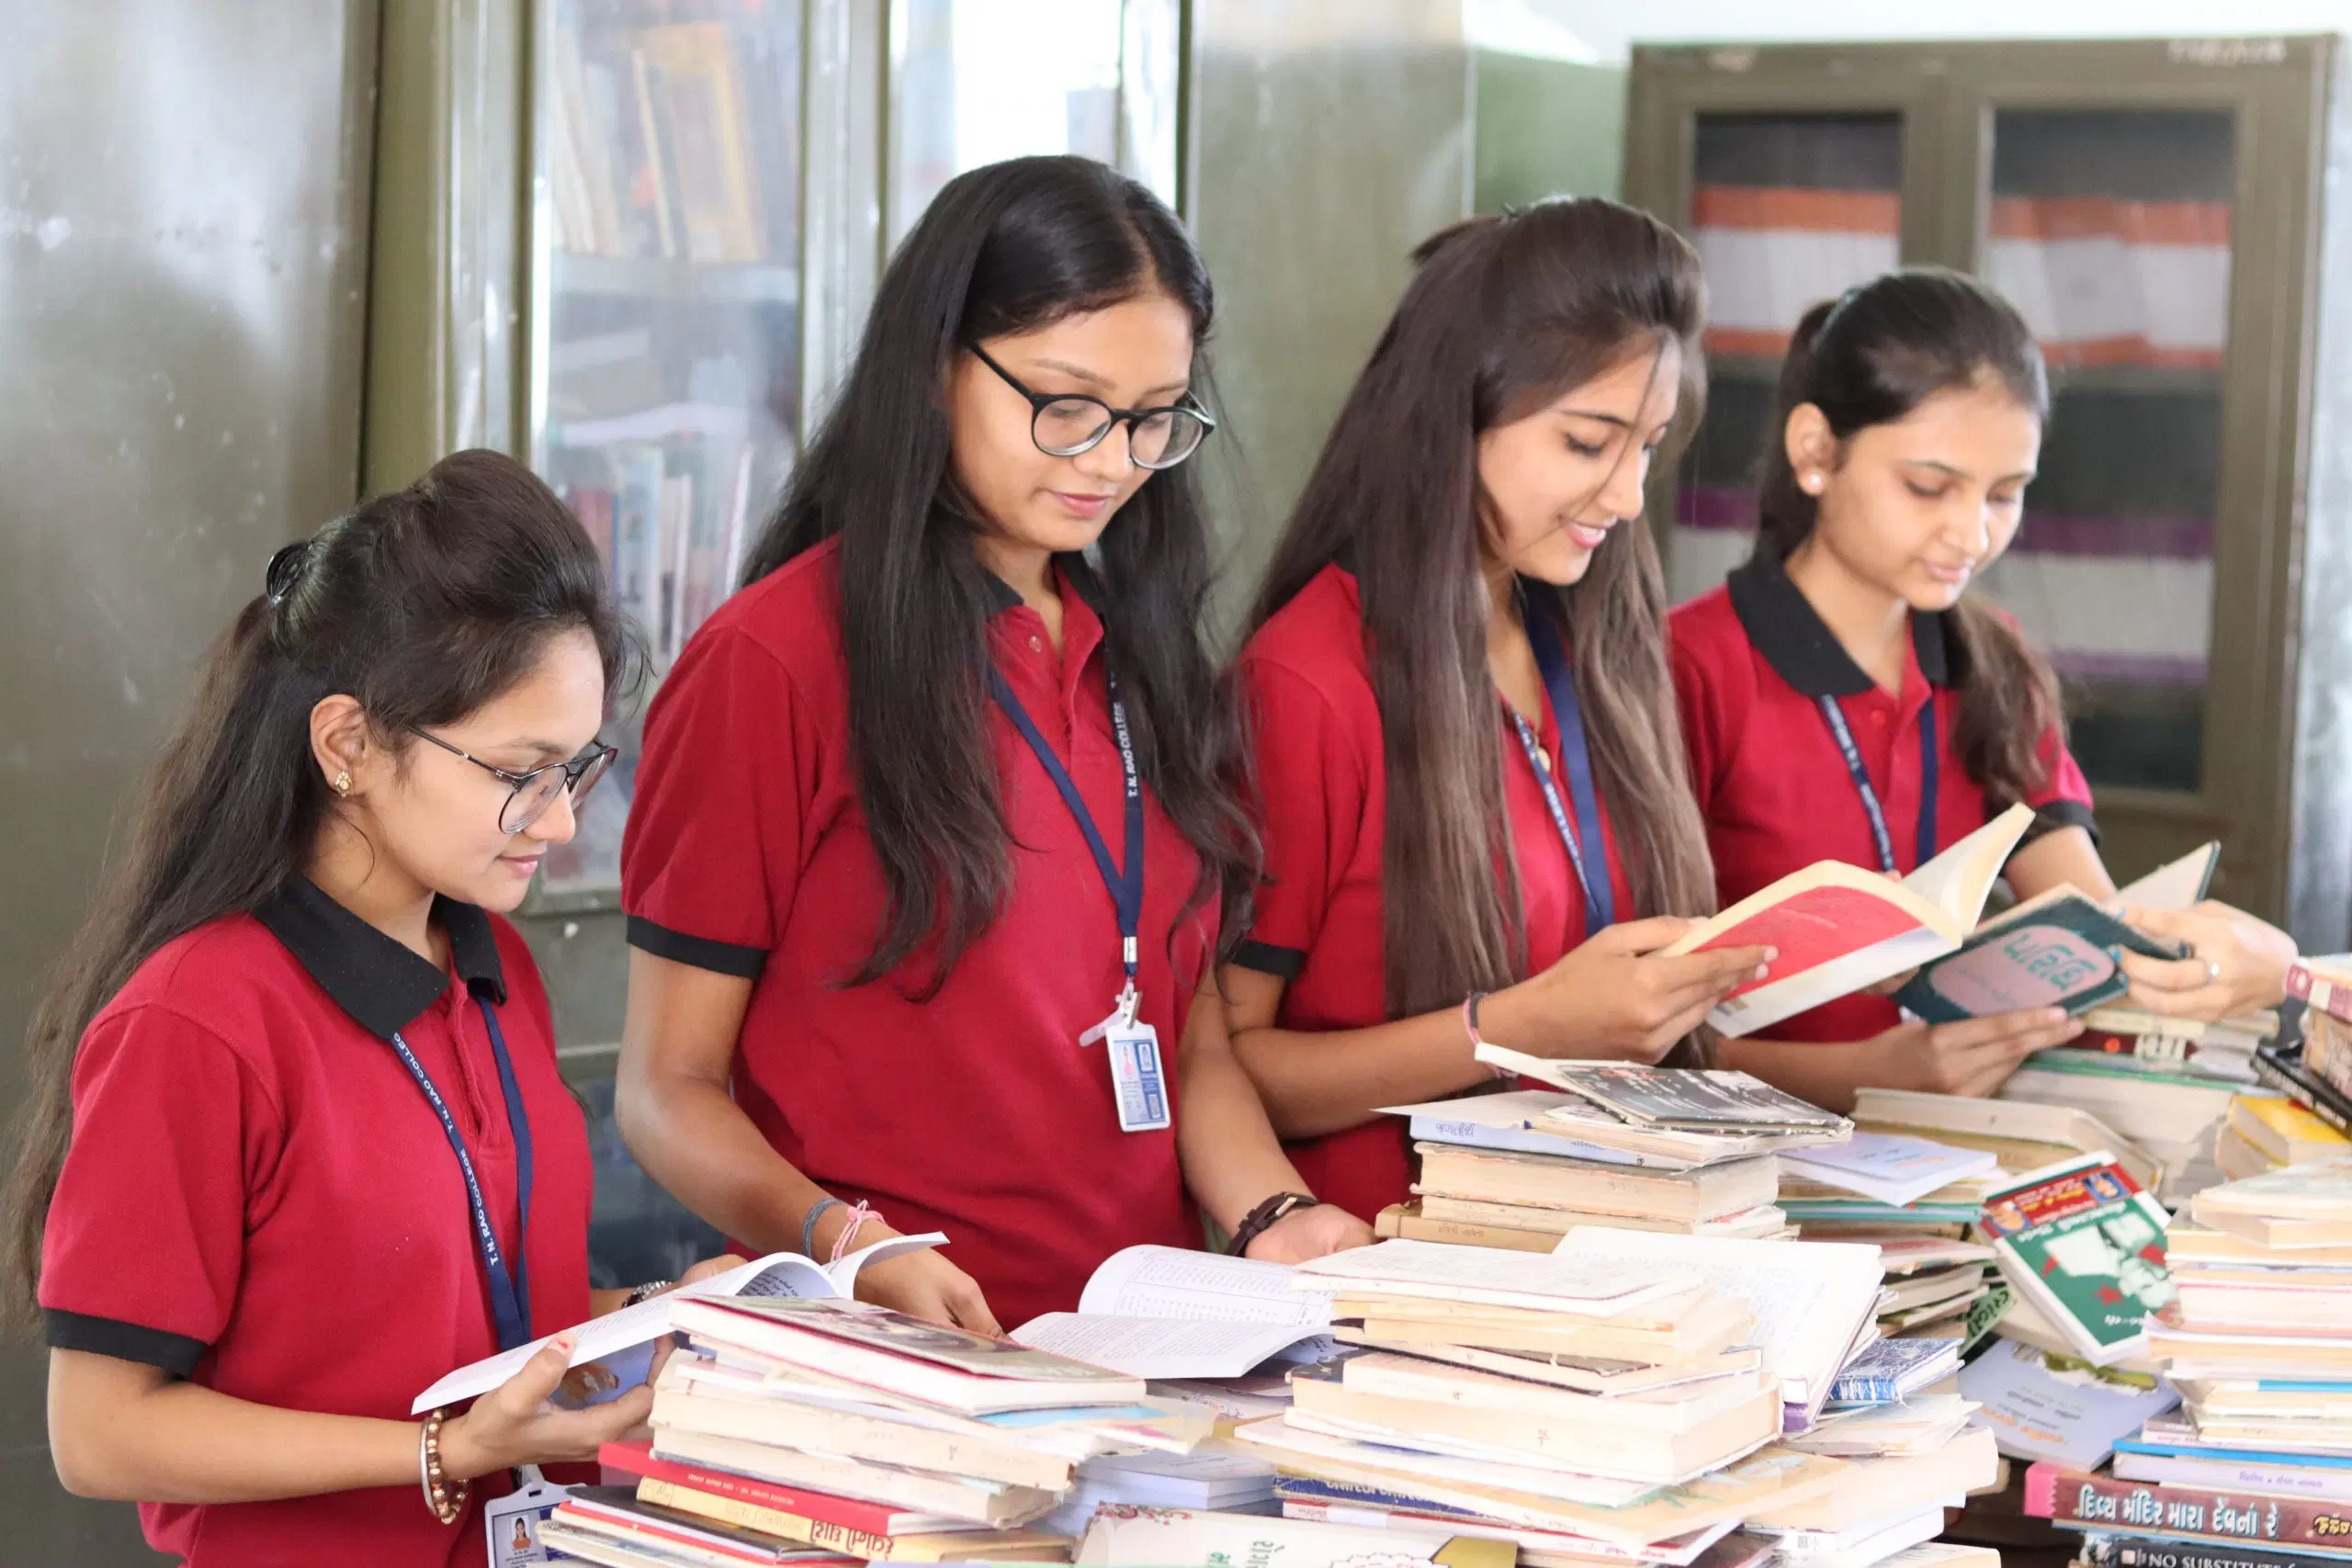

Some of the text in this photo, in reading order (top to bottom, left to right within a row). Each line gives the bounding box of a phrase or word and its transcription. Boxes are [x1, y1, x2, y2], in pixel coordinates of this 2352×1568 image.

[1123, 750, 1136, 773] RAO
[1127, 775, 1138, 787] N.
[1127, 788, 1138, 797] T.
[392, 1032, 455, 1133] T. N. RAO COLLEG
[459, 1147, 500, 1267] T. N. RAO COLLEGE
[2121, 1487, 2165, 1527] મંદિર
[2167, 1502, 2205, 1531] મારા
[2149, 1552, 2177, 1568] NO
[2181, 1555, 2281, 1568] SUBSTIT
